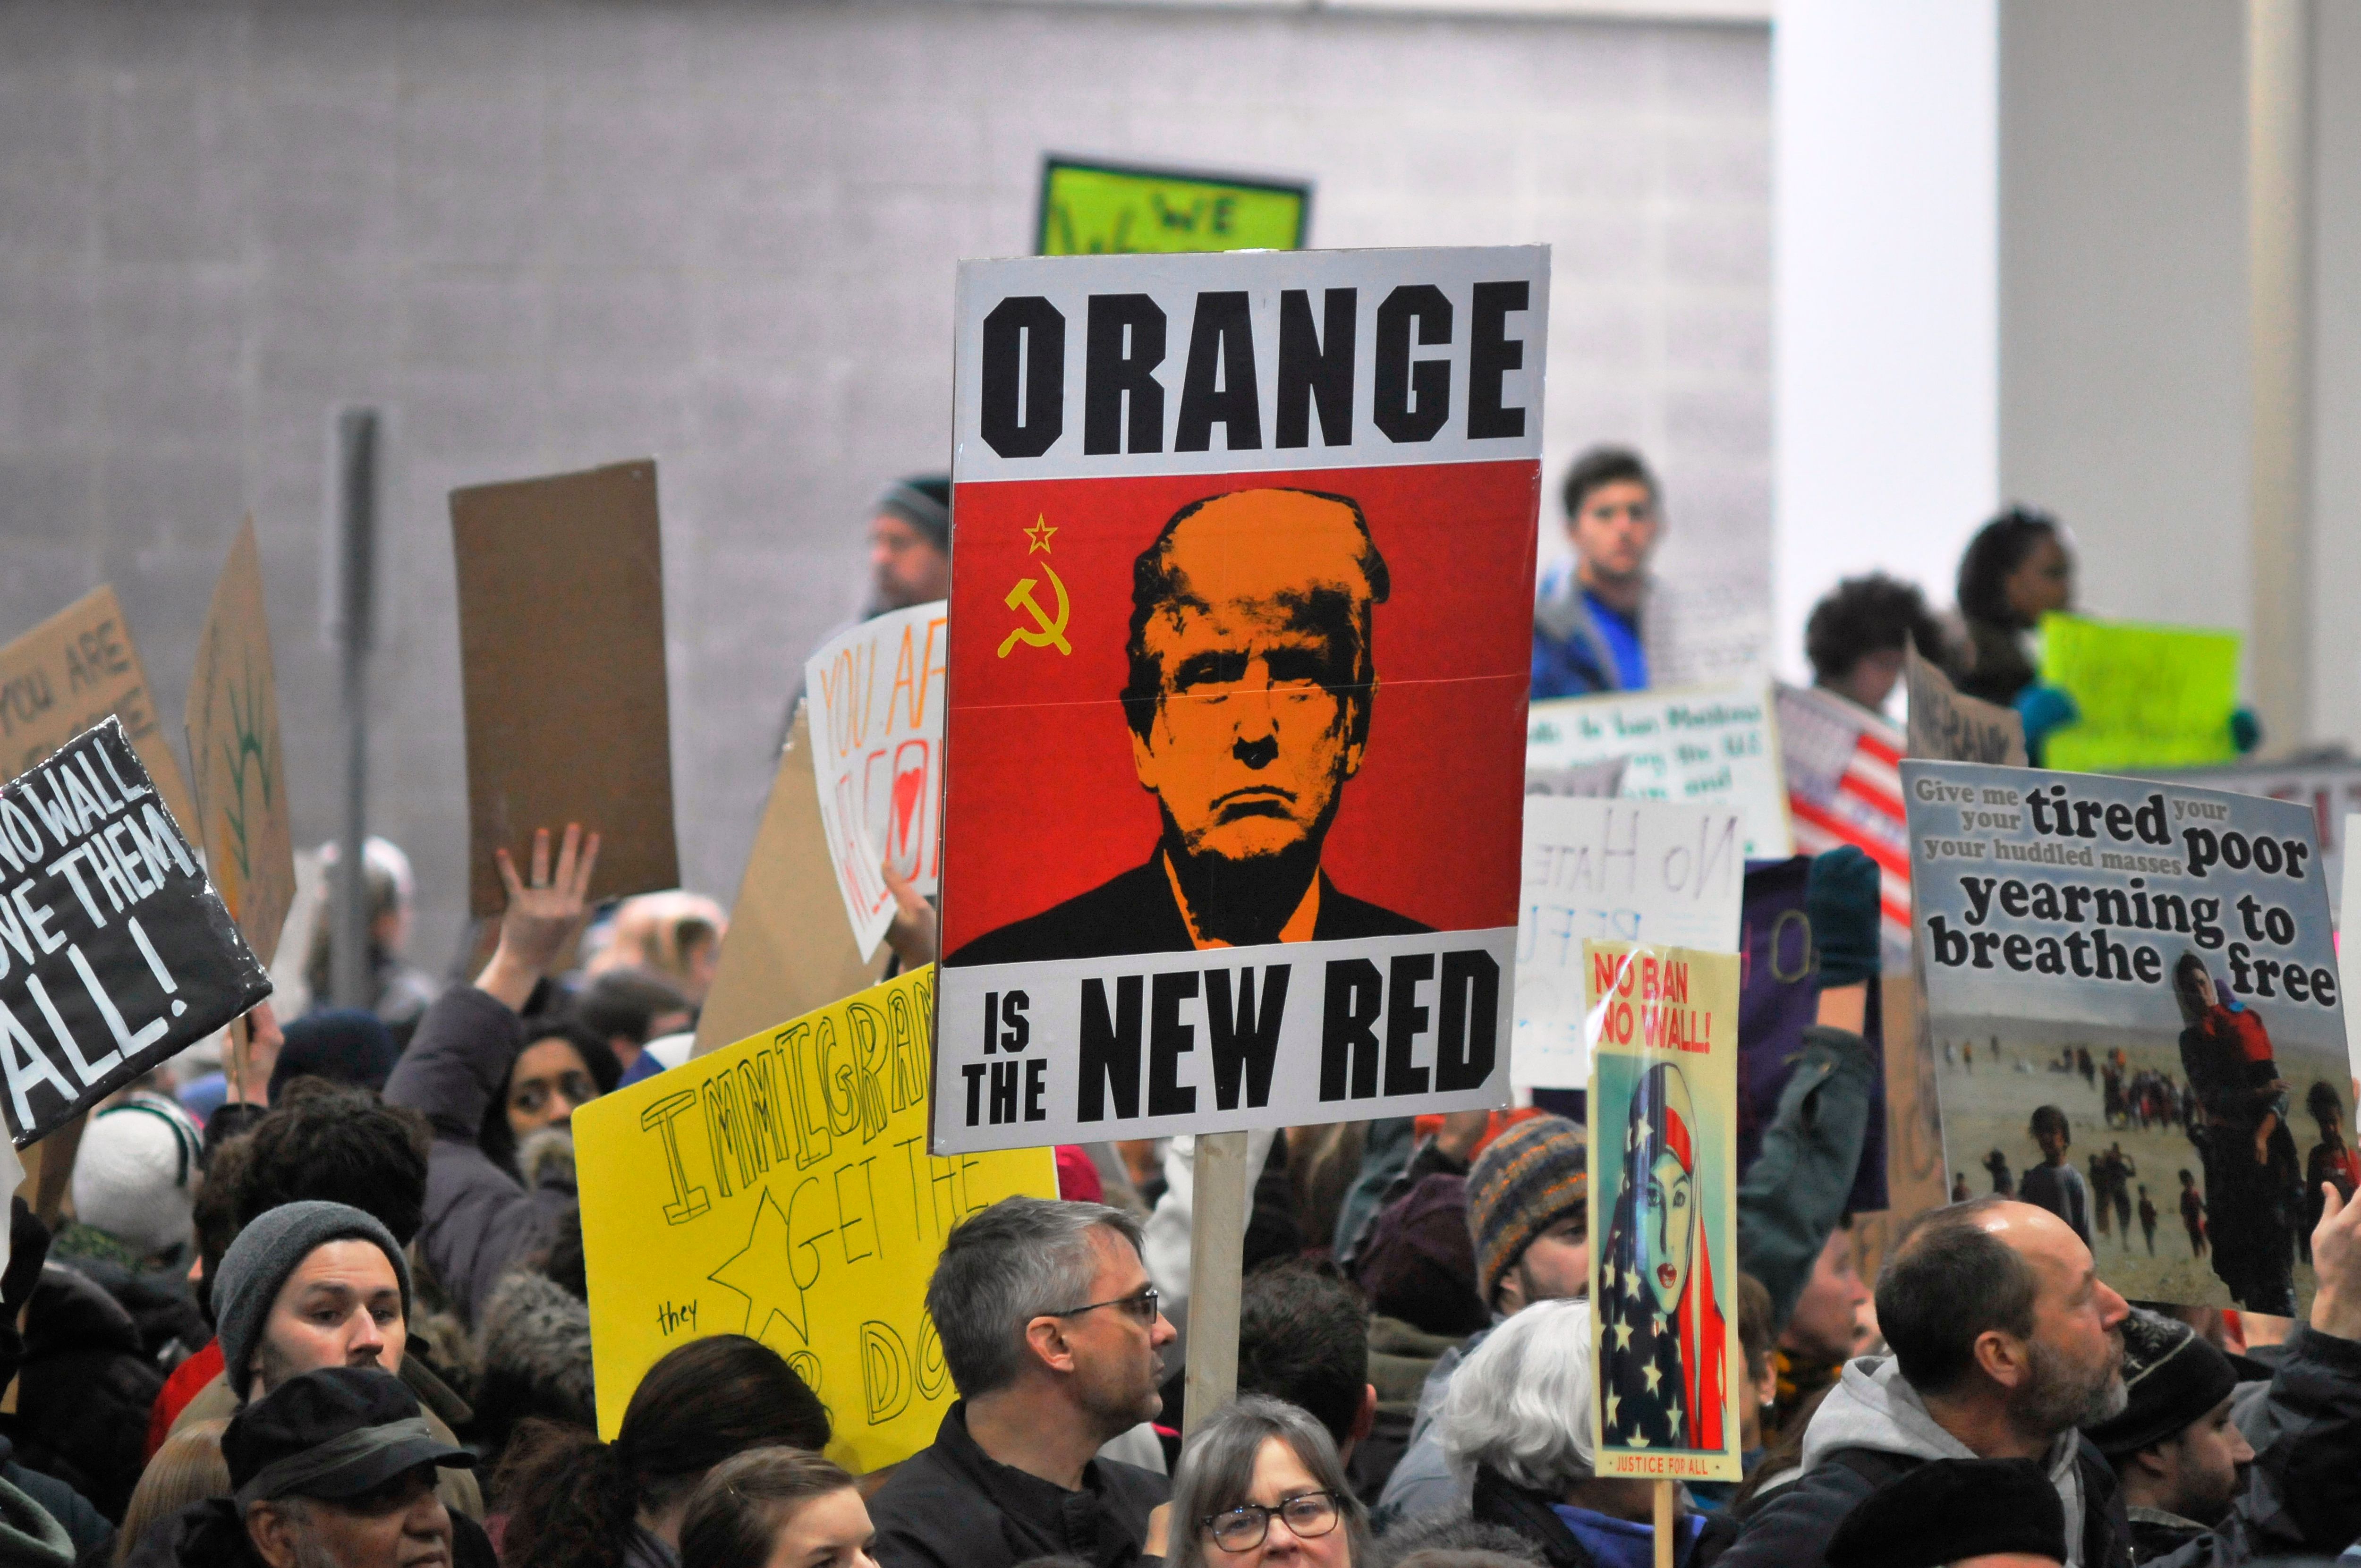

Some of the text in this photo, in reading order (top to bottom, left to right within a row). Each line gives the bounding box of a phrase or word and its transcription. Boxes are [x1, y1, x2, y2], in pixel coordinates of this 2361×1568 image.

[981, 280, 1530, 459] ORANGE
[65, 619, 130, 693] ARE
[820, 637, 876, 770] YOU
[21, 737, 147, 847] WALL
[1916, 779, 2019, 806] Give me
[1961, 785, 2172, 845] your tired
[2173, 800, 2227, 821] your
[1924, 838, 2182, 876] your huddled masses
[2182, 827, 2309, 879] poor
[0, 802, 195, 980] VE THEM
[1960, 876, 2295, 950] yearning to
[1594, 952, 1689, 1004] NO BAN
[1927, 915, 2337, 1007] breathe free
[0, 916, 187, 1130] ALL!
[983, 989, 1030, 1055] IS
[1077, 963, 1292, 1123] NEW
[1318, 949, 1501, 1103] RED
[1597, 999, 1634, 1046] NO
[1641, 1004, 1712, 1054] WALL!
[960, 1057, 1047, 1127] THE
[787, 1135, 989, 1291] GET THE
[656, 1298, 698, 1337] they
[1616, 1456, 1708, 1475] JUSTICE FOR ALL
